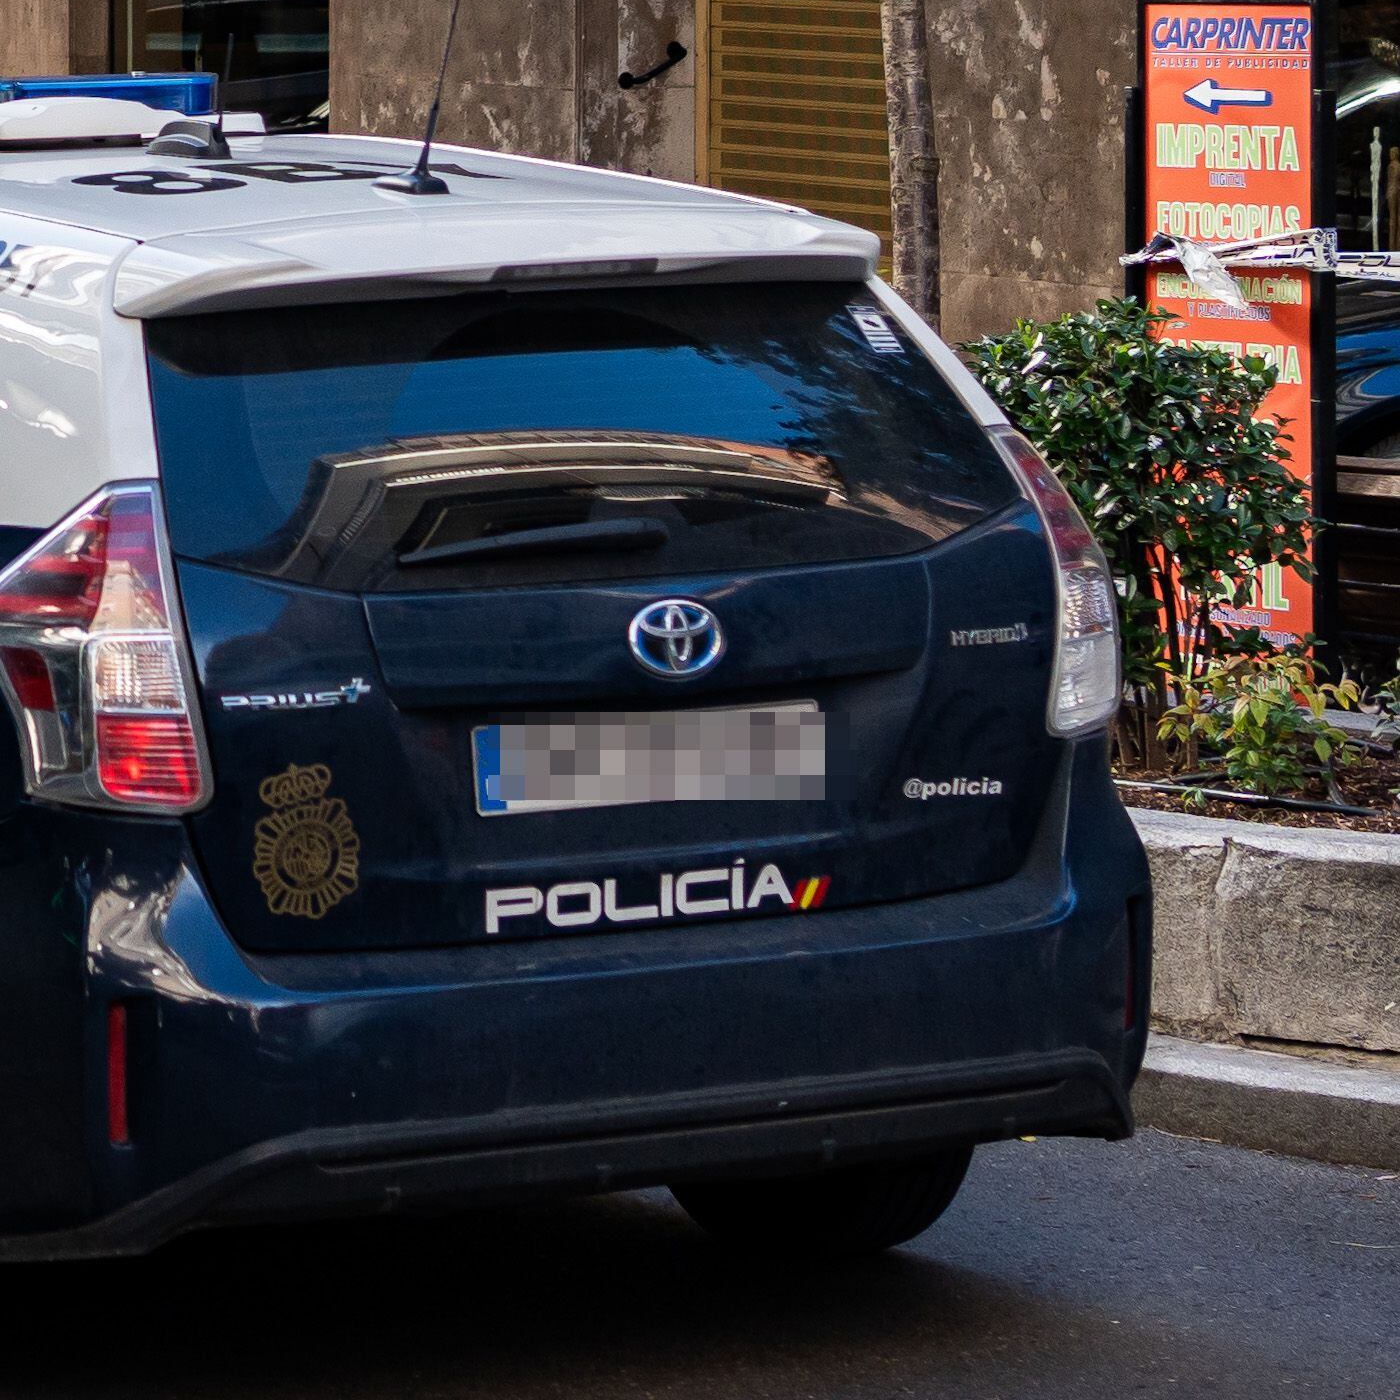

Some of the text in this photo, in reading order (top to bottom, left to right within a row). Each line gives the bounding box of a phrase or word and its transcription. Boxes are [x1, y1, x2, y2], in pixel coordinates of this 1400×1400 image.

[1151, 16, 1312, 51] CARPRINTER
[1153, 57, 1199, 69] TALLER
[1205, 57, 1222, 69] DE
[1156, 122, 1300, 172] IMPRENTA
[1156, 201, 1301, 240] FOTOCOPIAS
[1156, 272, 1302, 306] ENCUNACIÓN
[903, 776, 1003, 800] @policia
[485, 857, 795, 935] POLICÍA
